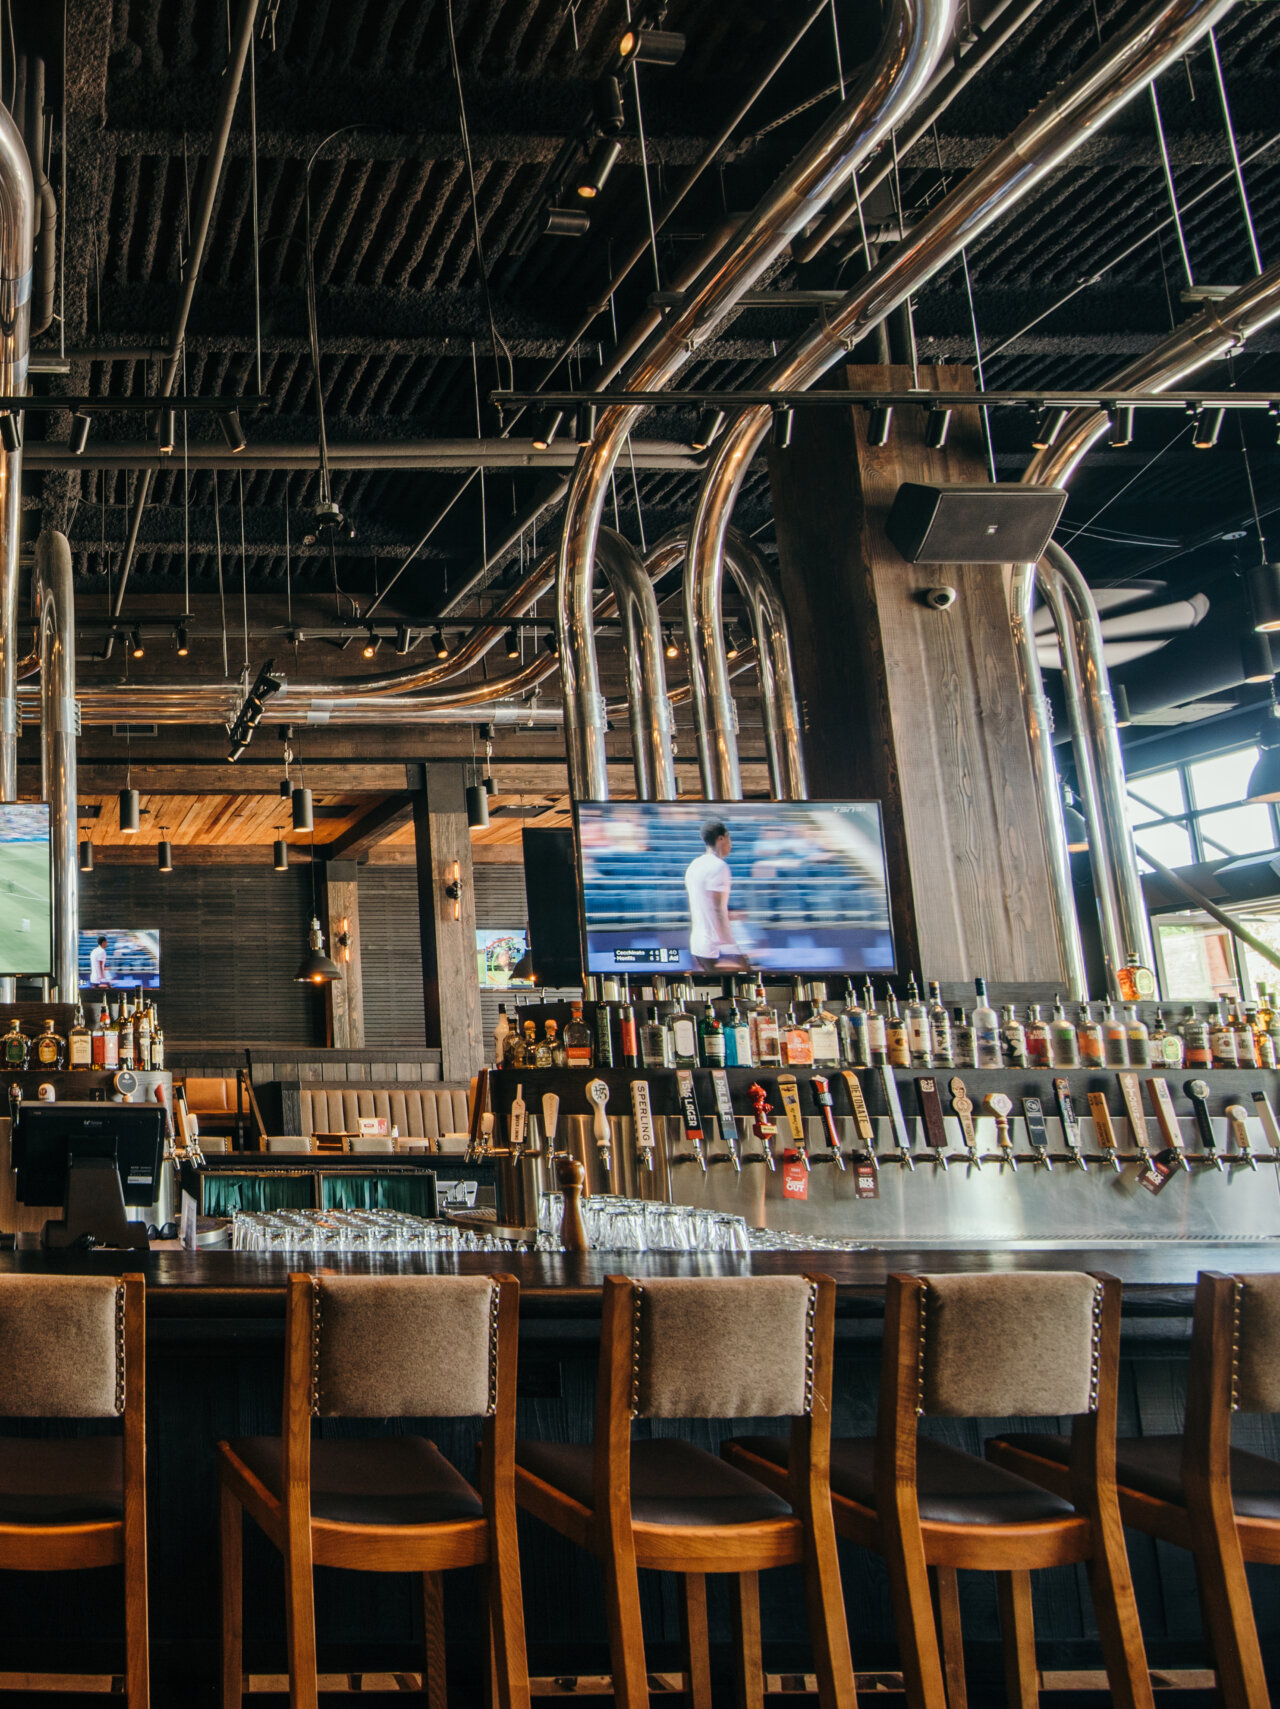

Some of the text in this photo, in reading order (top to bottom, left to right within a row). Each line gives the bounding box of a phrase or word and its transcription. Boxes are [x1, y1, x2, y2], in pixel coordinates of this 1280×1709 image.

[681, 1080, 698, 1127] 1516 LAGER
[715, 1080, 728, 1104] PALE
[850, 1084, 869, 1124] DETONATE
[637, 1085, 650, 1141] SPERLING
[786, 1183, 805, 1193] OUT
